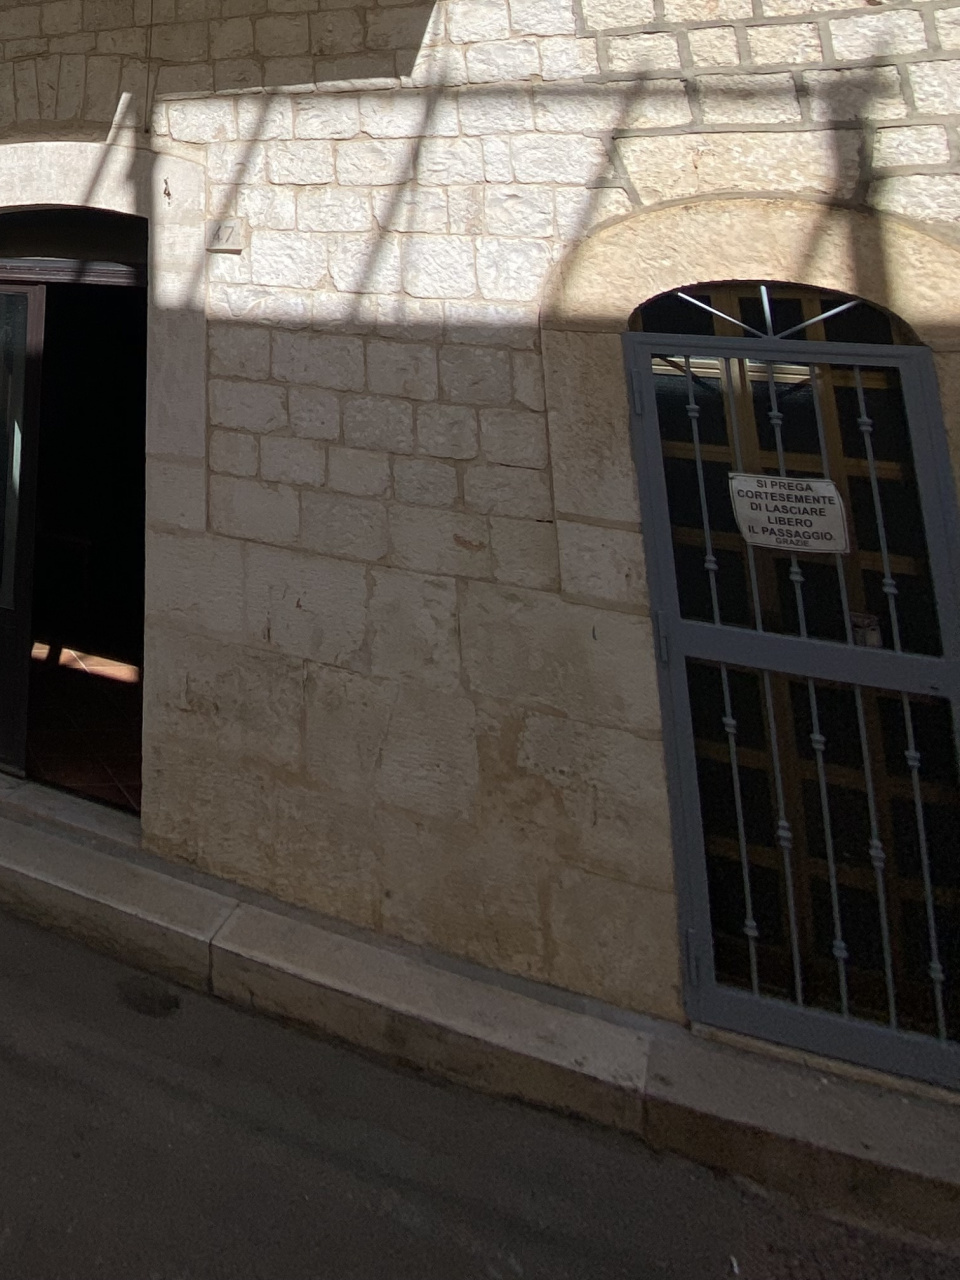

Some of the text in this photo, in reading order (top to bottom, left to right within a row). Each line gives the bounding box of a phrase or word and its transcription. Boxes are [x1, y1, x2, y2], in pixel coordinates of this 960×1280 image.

[756, 479, 814, 493] SI PREGA
[737, 489, 836, 505] CORTESEMENTE
[750, 502, 827, 517] DI LASCIARE
[767, 516, 813, 528] LIBERO
[748, 525, 759, 535] IL
